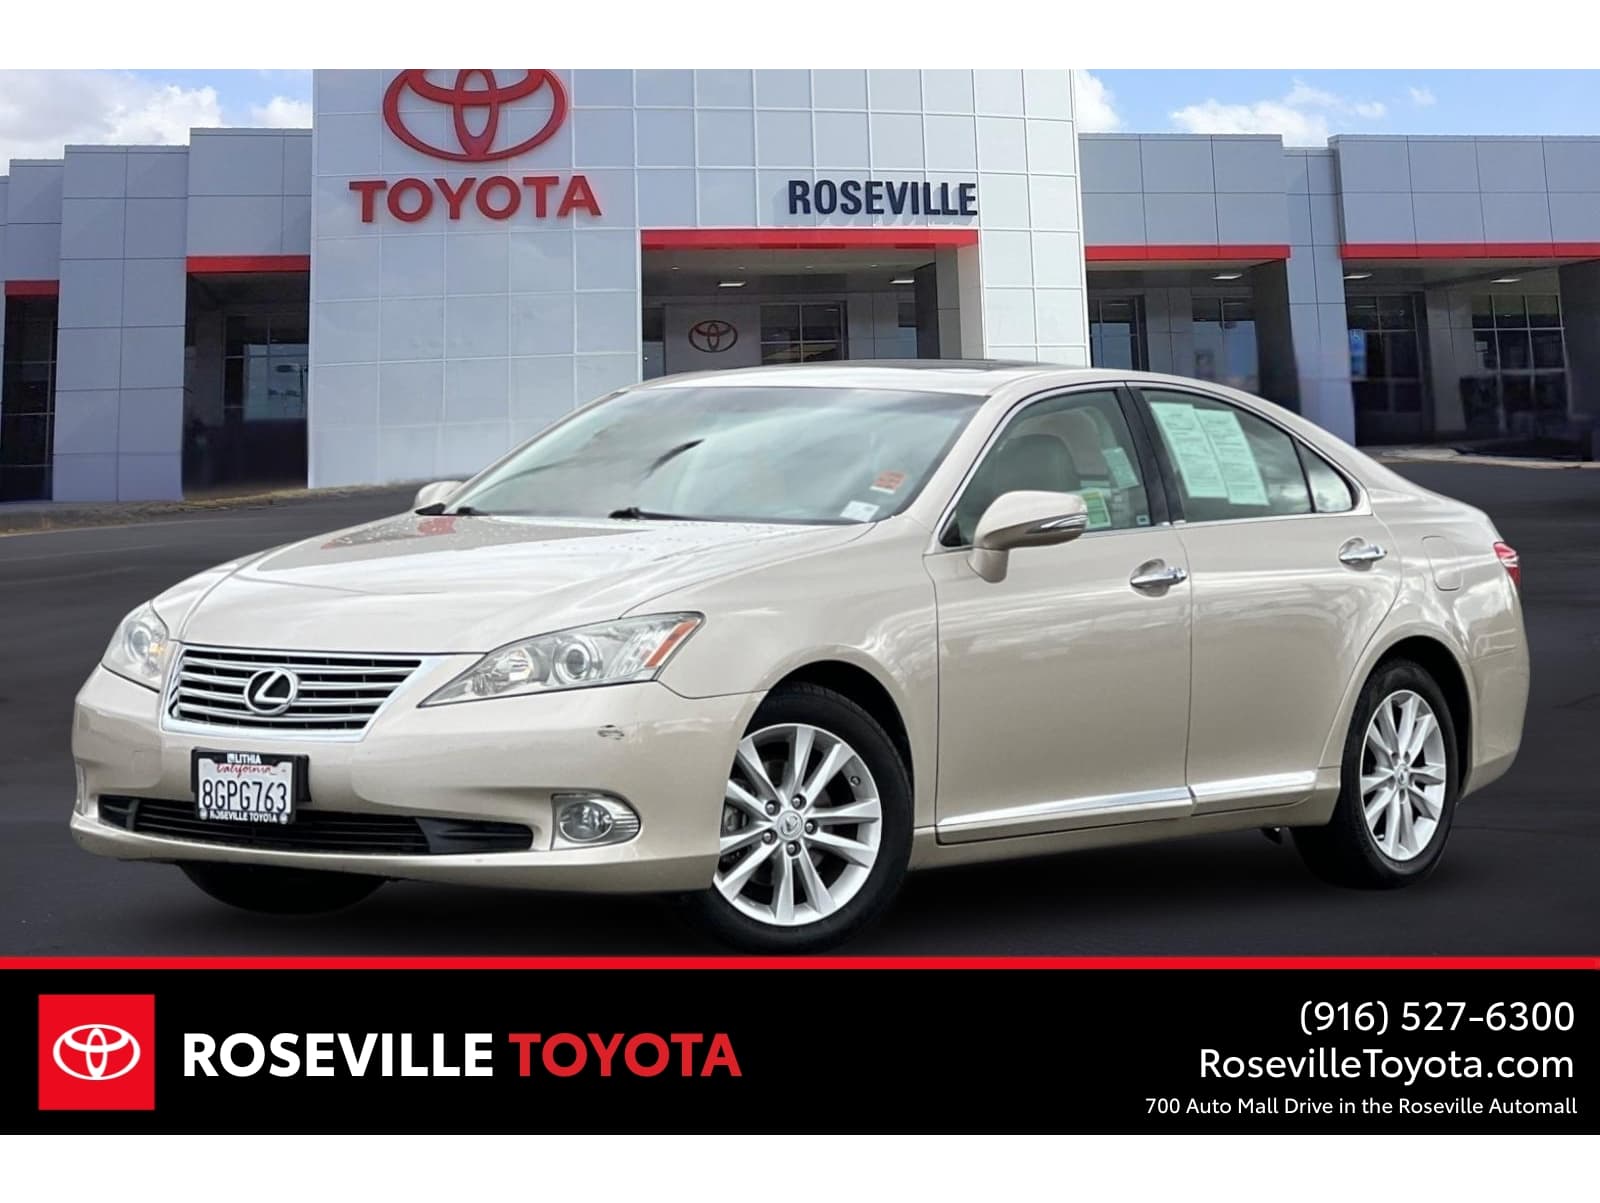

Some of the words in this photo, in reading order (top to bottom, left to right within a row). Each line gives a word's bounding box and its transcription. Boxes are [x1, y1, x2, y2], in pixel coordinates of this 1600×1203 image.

[349, 175, 602, 223] TOYOTA
[788, 179, 978, 217] ROSEVILLE
[216, 763, 274, 778] California
[234, 752, 262, 765] LITHIA
[202, 778, 288, 813] 8GPG763
[209, 810, 249, 821] ROSEVILLE
[249, 812, 278, 823] TOYOTA
